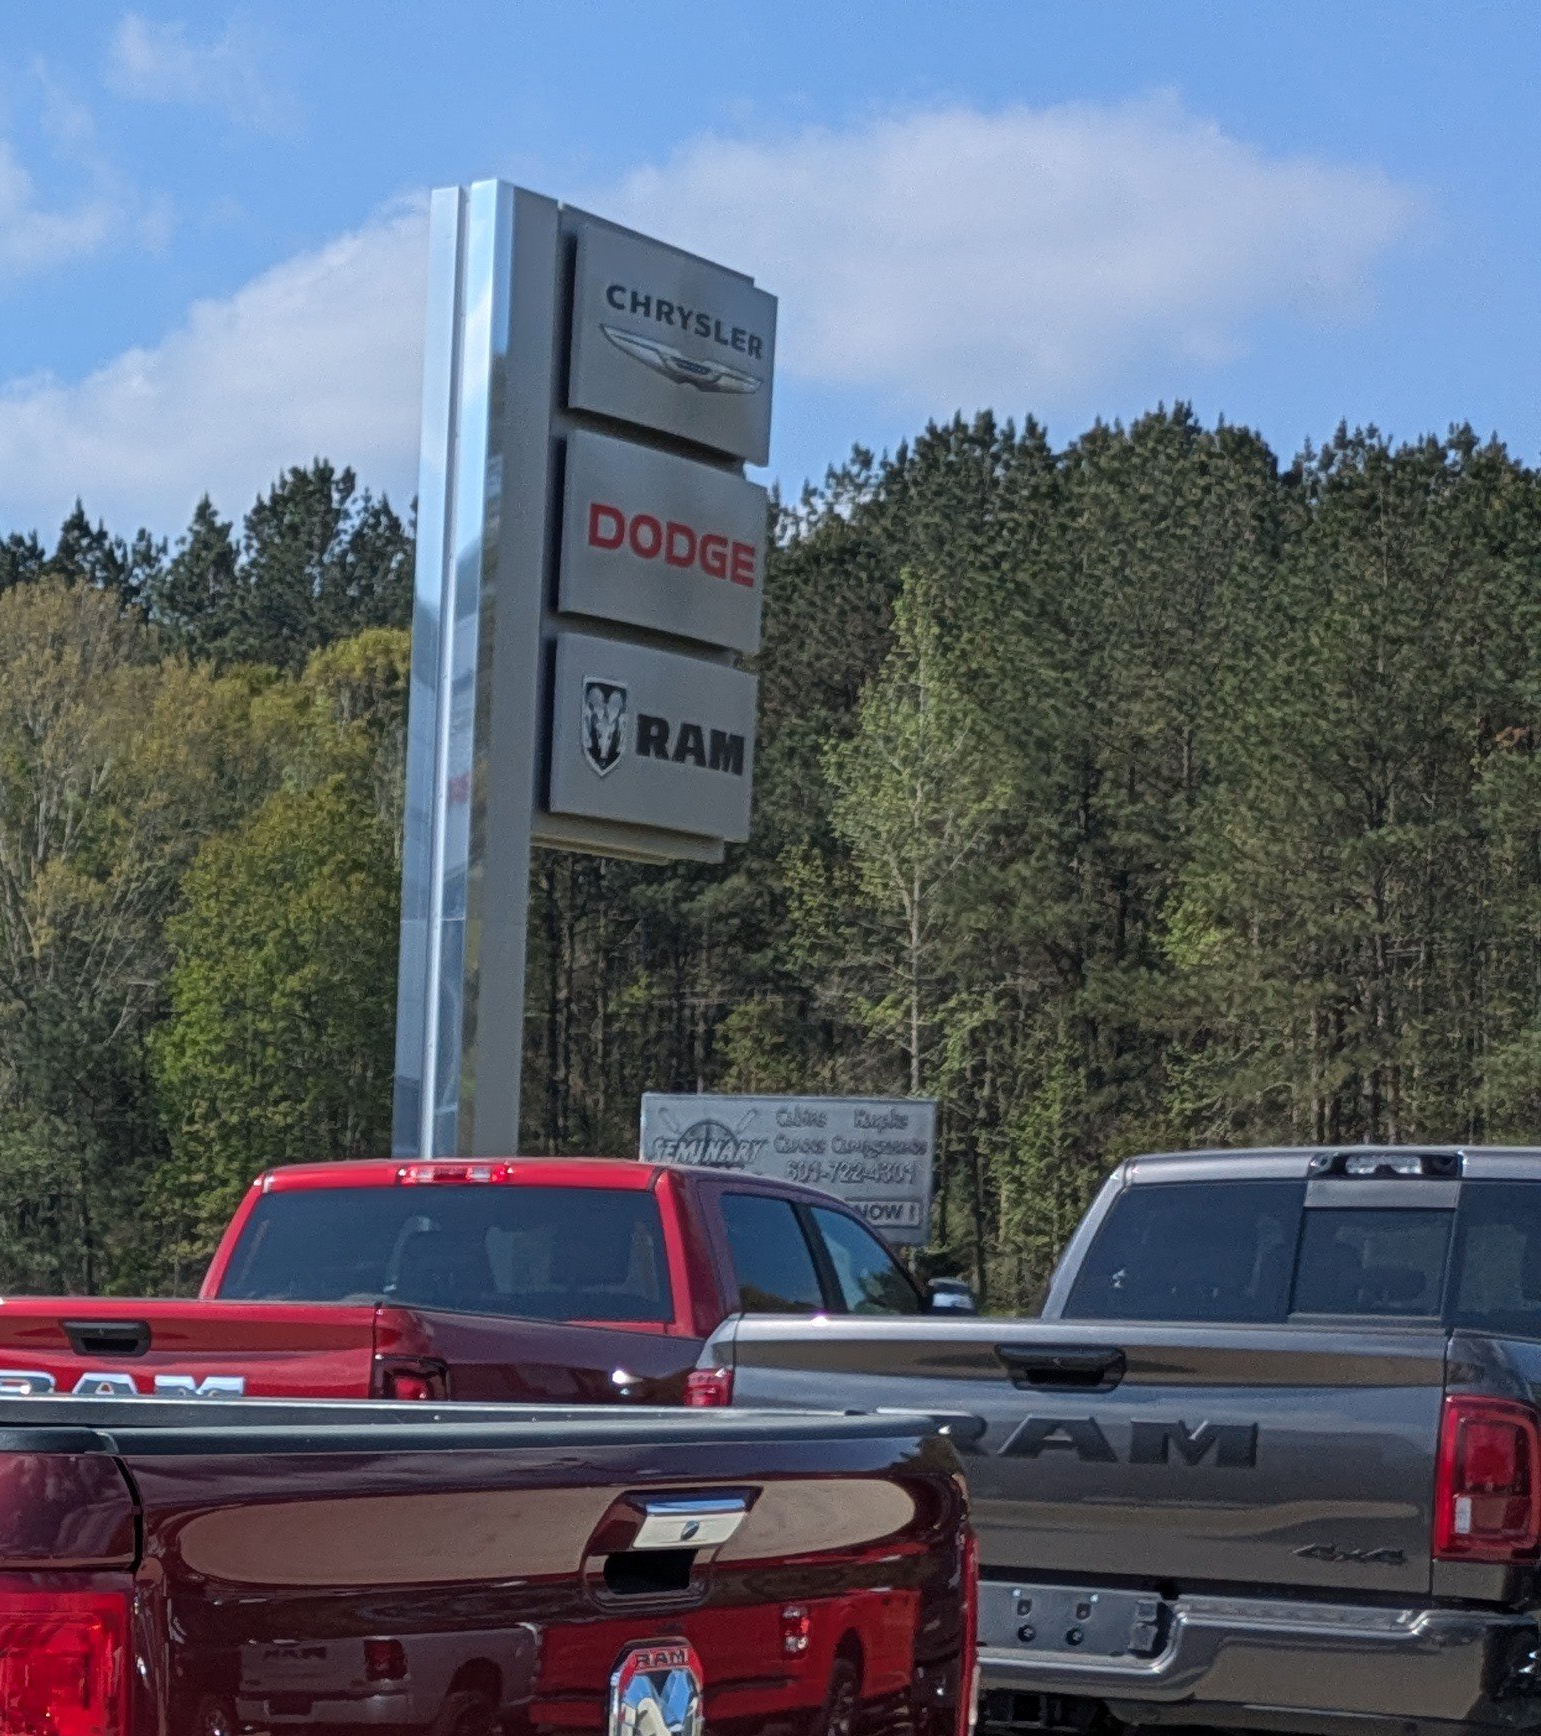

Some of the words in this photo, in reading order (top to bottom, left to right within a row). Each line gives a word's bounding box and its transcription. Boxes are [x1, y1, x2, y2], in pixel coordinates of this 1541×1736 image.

[605, 283, 764, 360] CHRYSLER
[588, 502, 756, 588] DODGE
[635, 713, 745, 776] RAM
[652, 1136, 768, 1165] SEMINARY
[634, 1650, 688, 1669] RAM
